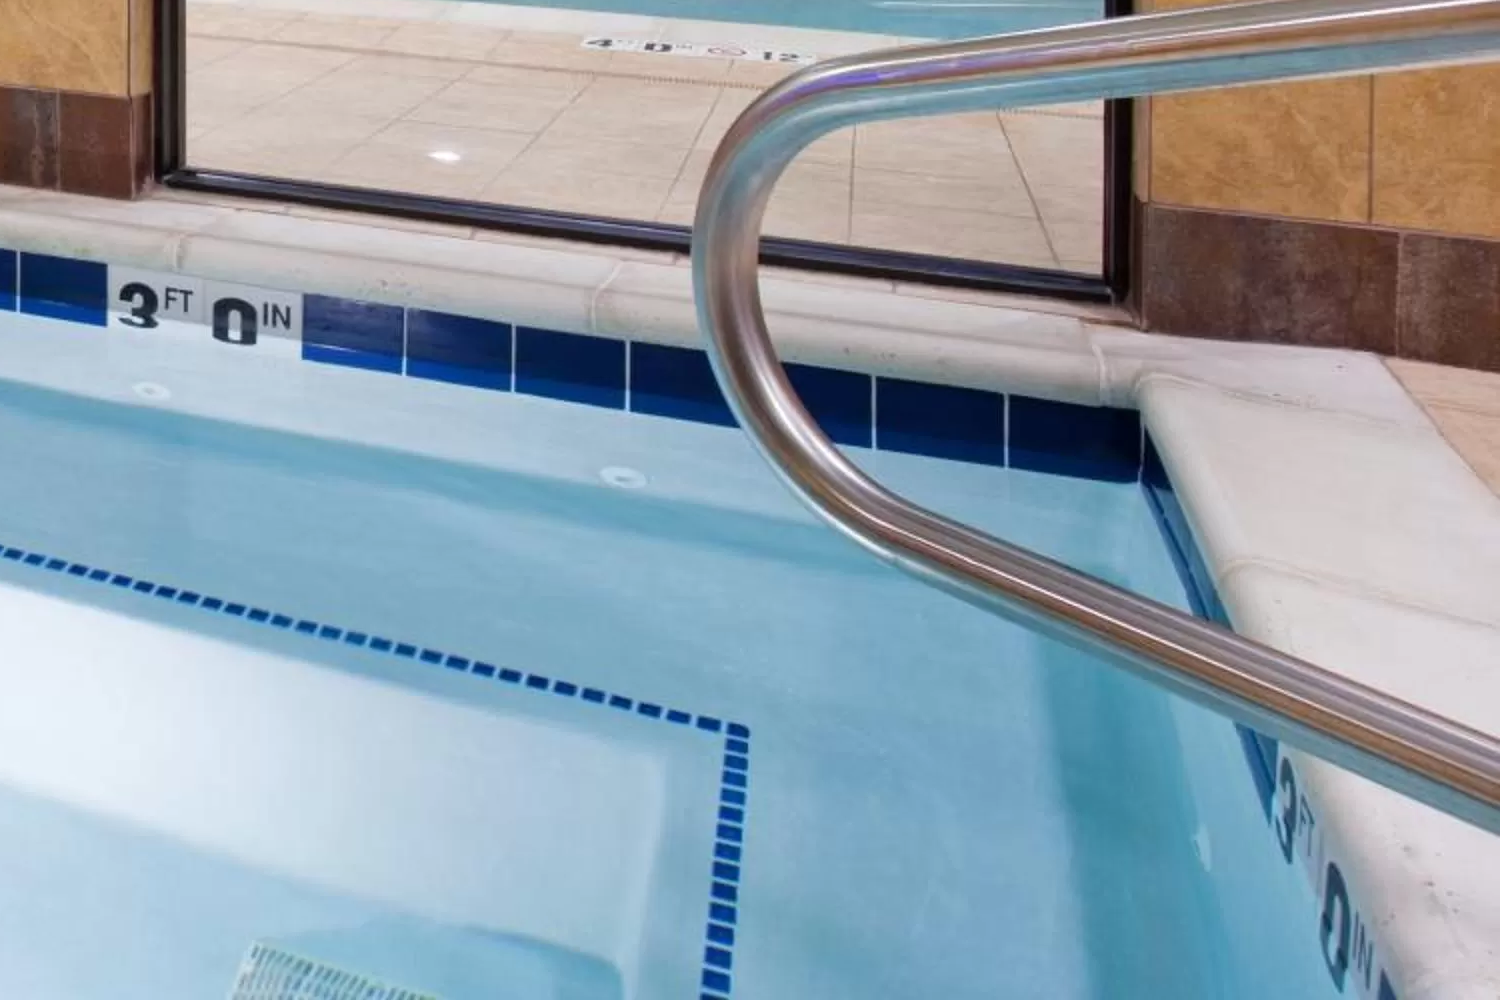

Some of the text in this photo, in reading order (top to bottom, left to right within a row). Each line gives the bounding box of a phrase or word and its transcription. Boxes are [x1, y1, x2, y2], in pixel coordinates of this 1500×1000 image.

[118, 281, 291, 346] 3 FT 0 IN
[1274, 757, 1297, 865] 3
[1352, 910, 1374, 991] IN
